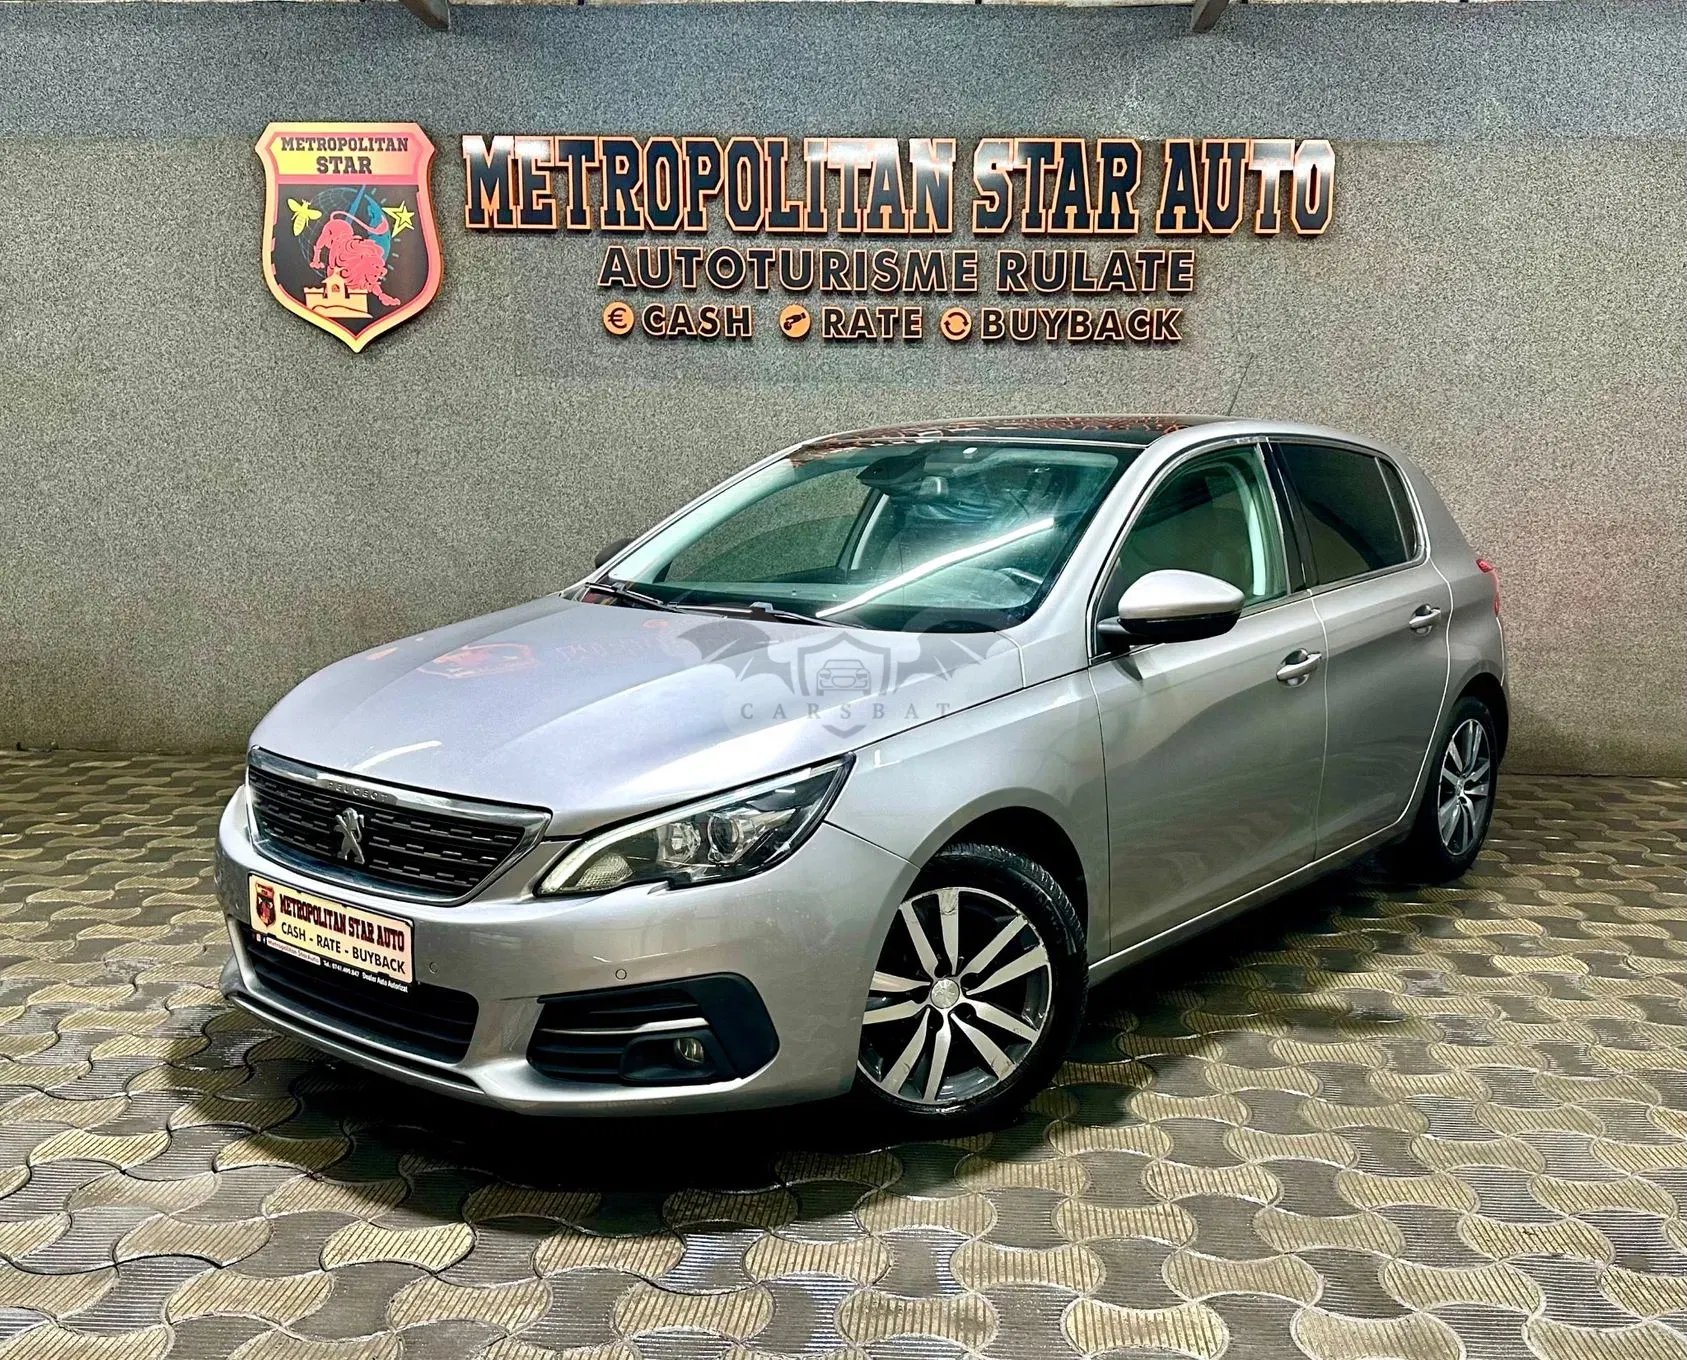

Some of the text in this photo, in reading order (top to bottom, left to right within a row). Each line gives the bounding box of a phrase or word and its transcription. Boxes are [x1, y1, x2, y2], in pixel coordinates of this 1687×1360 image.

[281, 137, 408, 152] METROPOLITAN
[316, 156, 372, 174] STAR
[462, 135, 1336, 236] METROPOLITAN STAR AUTO
[598, 245, 1196, 293] AUTOTURISME RULATE
[642, 304, 753, 338] CASH
[821, 306, 923, 339] RATE
[980, 306, 1184, 341] BUYBACK
[328, 781, 388, 802] PEUGEOT
[279, 894, 405, 952] METROPOLITAN STAR AUTO
[281, 922, 306, 941] CASH
[317, 935, 341, 954] RATE
[352, 946, 405, 974] BUYBACK
